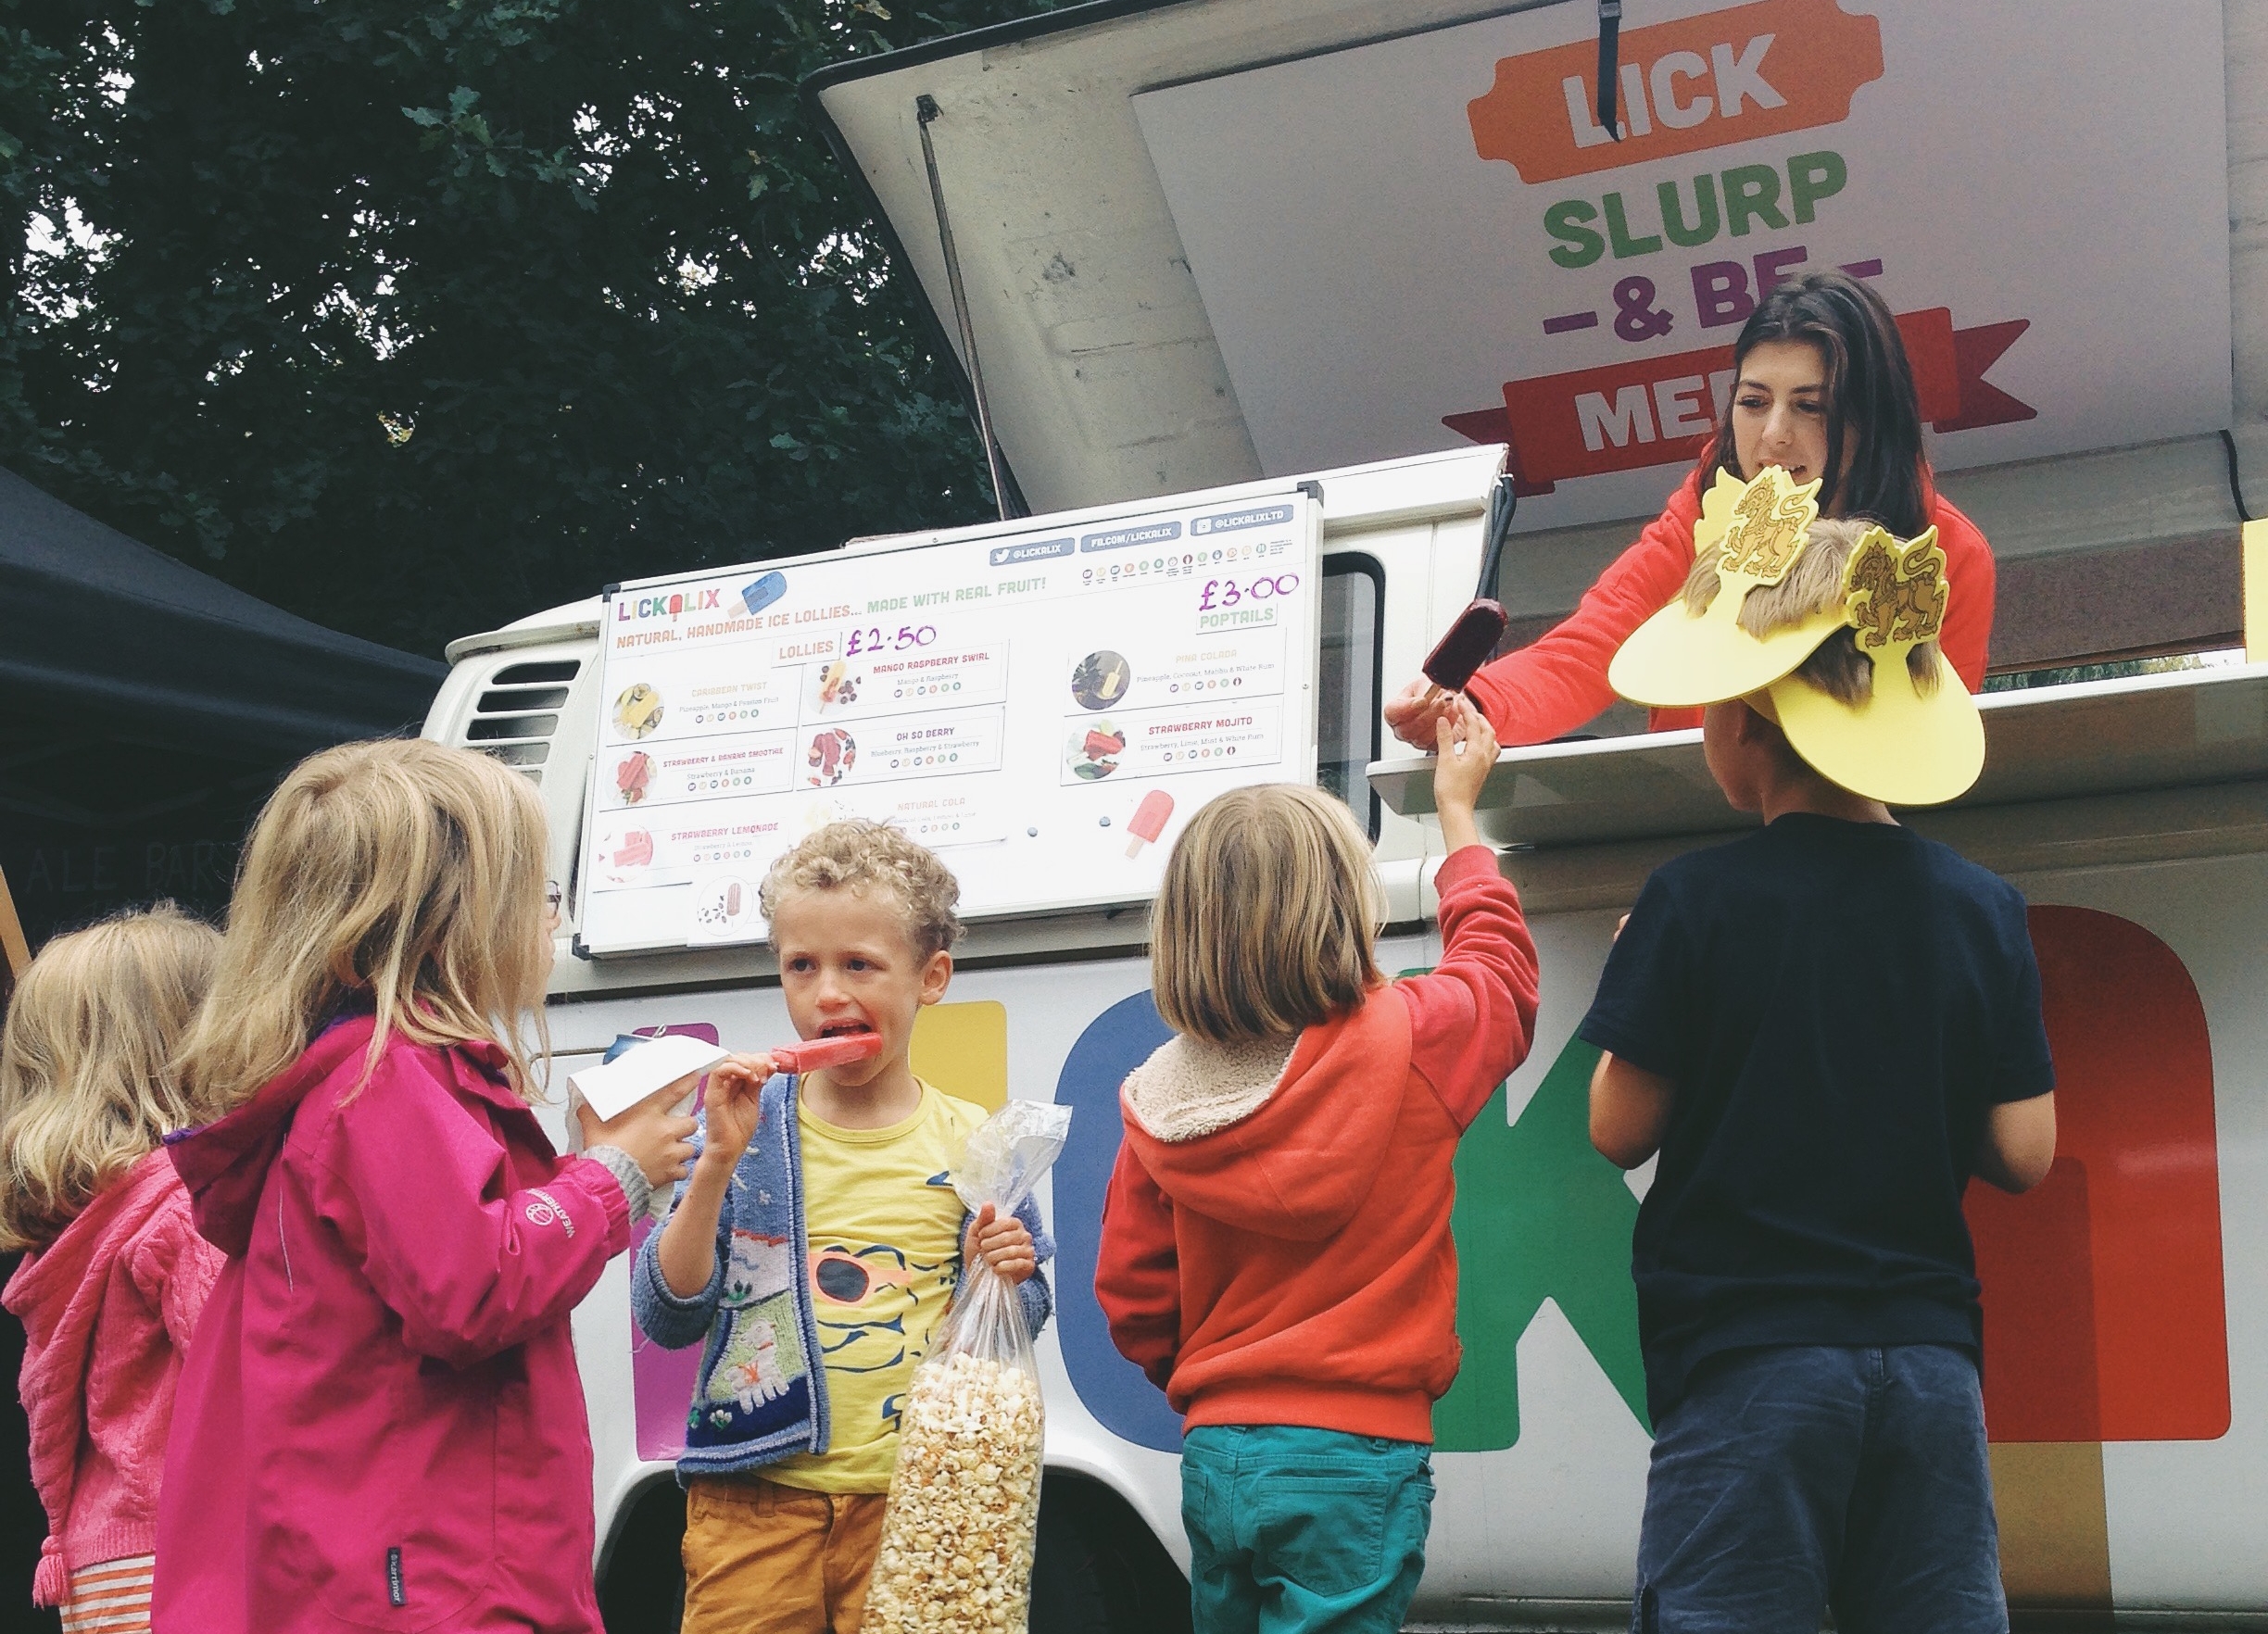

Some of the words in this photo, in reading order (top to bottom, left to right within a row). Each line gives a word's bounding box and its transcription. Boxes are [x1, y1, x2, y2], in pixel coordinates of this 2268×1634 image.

[1562, 33, 1787, 148] LICK
[1544, 151, 1847, 269] SLURP
[1613, 275, 1673, 342] &
[1575, 369, 1736, 451] ME
[1090, 527, 1172, 548] FB.COM/LICKALIX
[1013, 544, 1061, 559] @LICKALIX
[616, 630, 682, 648] NATURAL,
[687, 617, 762, 638] HANDMADE
[767, 612, 790, 628] ICE
[867, 597, 908, 613] MADE
[913, 591, 951, 608] WITH
[955, 584, 992, 601] REAL
[997, 577, 1047, 596] FRUIT!
[618, 588, 720, 622] LICKALIX
[1200, 608, 1274, 628] POPTAILS
[779, 640, 834, 660] LOLLIES
[1201, 649, 1238, 660] COLADA
[873, 663, 904, 673] MANGO
[907, 656, 959, 670] RASPBERRY
[962, 652, 989, 663] SWIRL
[691, 685, 738, 698] CARIBBEAN
[741, 682, 767, 692] TWIST
[896, 732, 908, 742] OH
[911, 730, 923, 740] SO
[926, 727, 955, 738] BERRY
[1148, 720, 1213, 735] STRAWBERRY
[1216, 716, 1253, 728] MOJITO
[662, 756, 709, 768] STRAWBERRY
[718, 751, 746, 761] BANANA
[748, 748, 784, 758] SMOOTHIE
[687, 770, 723, 780] Strawberry
[730, 767, 755, 775] Banana
[897, 799, 939, 811] NATURAL
[941, 797, 965, 808] COLA
[671, 827, 729, 841] STRAWBERRY
[731, 822, 779, 836] LEMONADE
[25, 846, 119, 895] ALE
